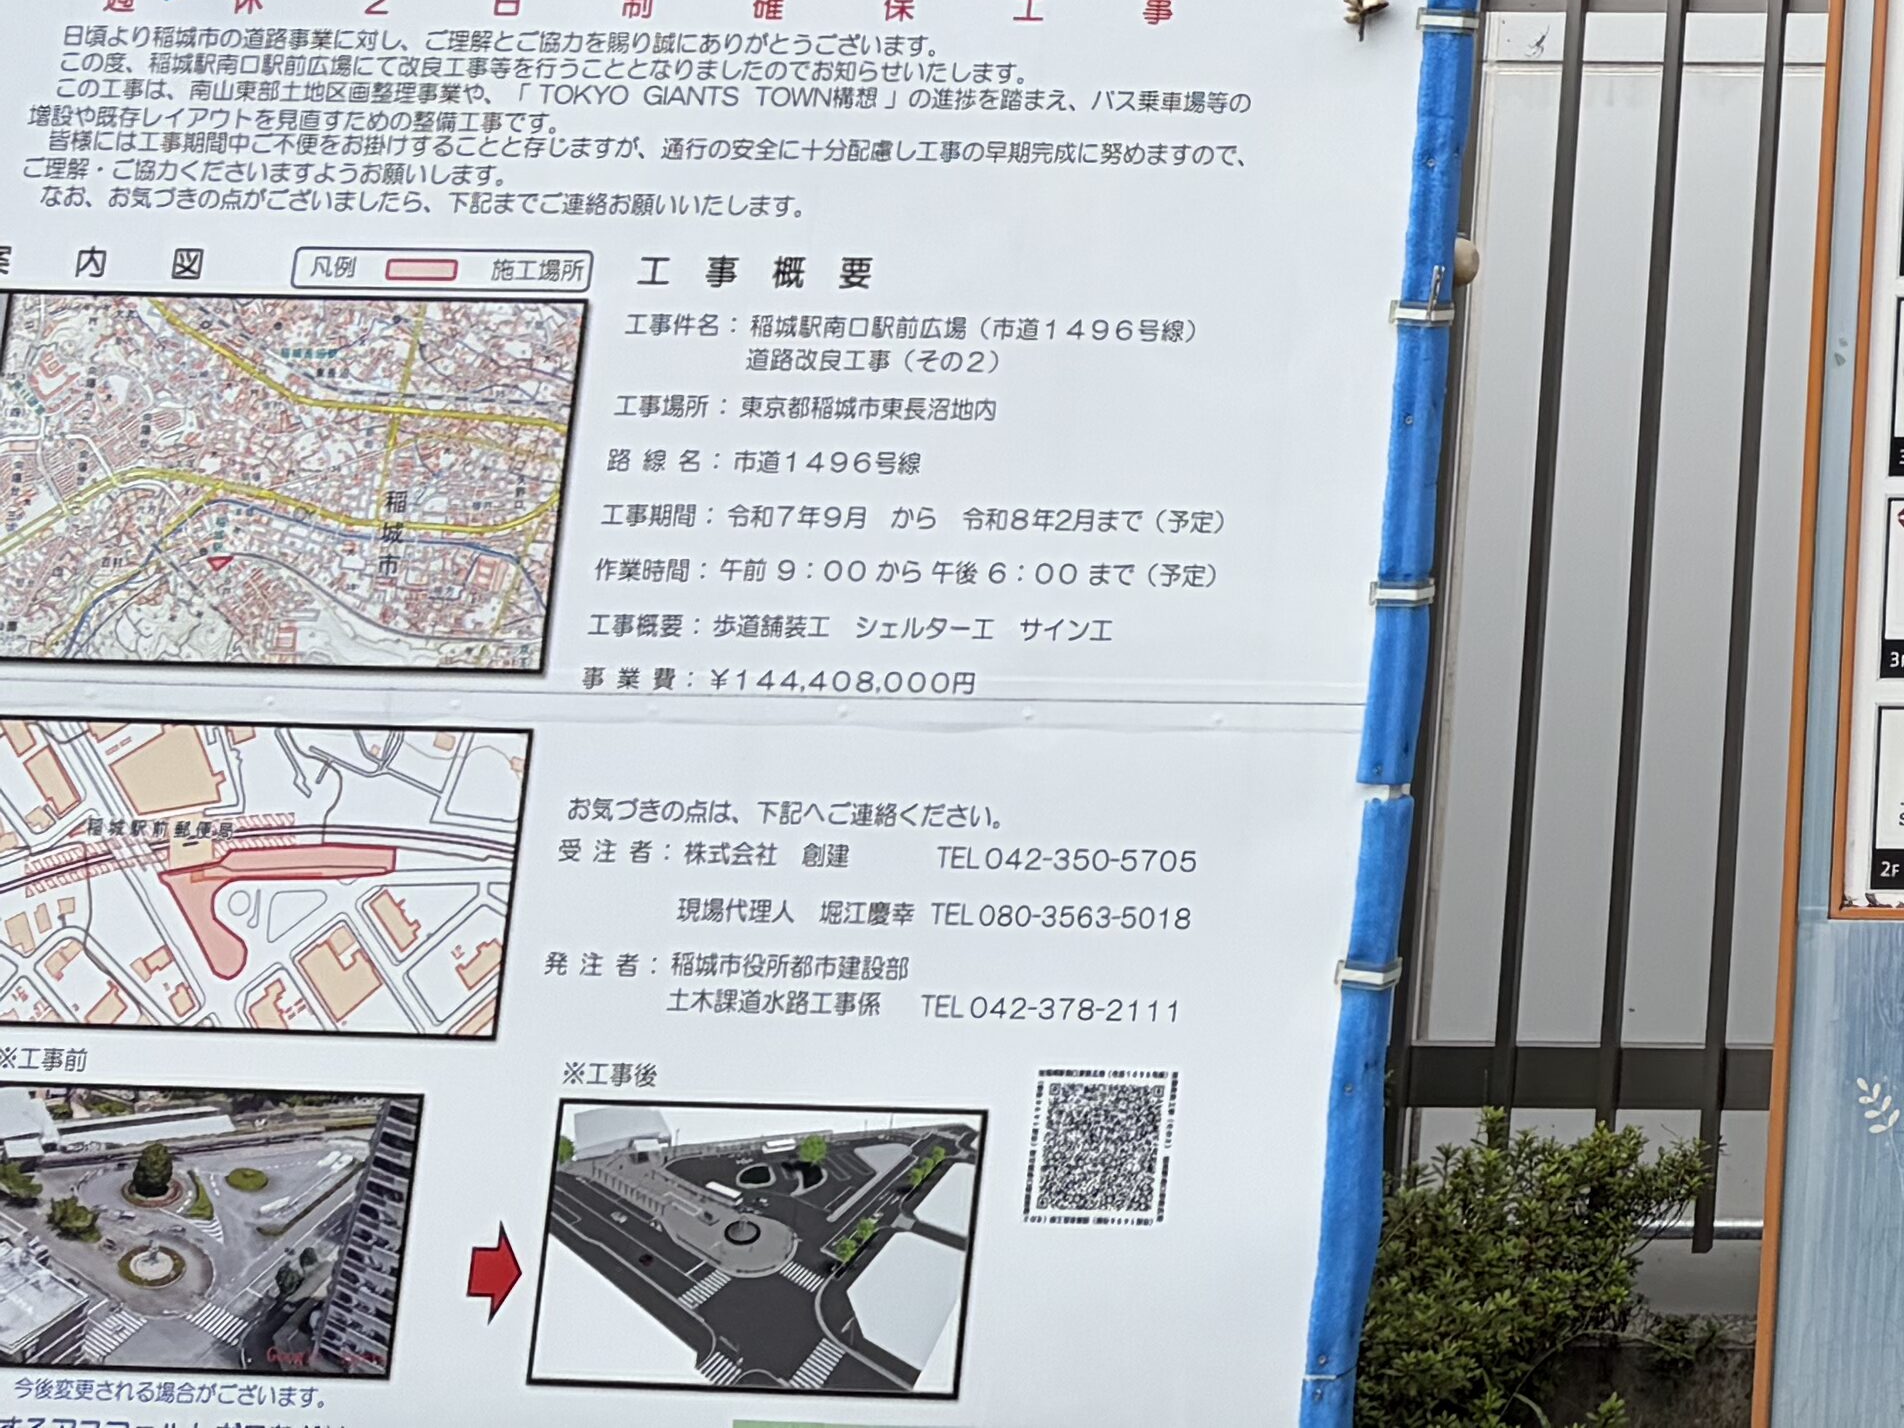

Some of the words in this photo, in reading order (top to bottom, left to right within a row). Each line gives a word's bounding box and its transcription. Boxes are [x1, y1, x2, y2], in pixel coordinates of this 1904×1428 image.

[540, 84, 629, 107] TOKYO
[644, 86, 739, 107] GIANTS
[27, 105, 557, 134] 増設や既存レイアウトを見直すための整備工事です。
[22, 158, 504, 188] ご理解・ご協力くださいますようお願いします。
[309, 255, 356, 278] 凡例
[490, 258, 585, 283] 施工場所
[739, 395, 997, 423] 東京都稲城市東長沼地内
[712, 613, 831, 639] 歩道舗装工
[568, 797, 1000, 830] お気づきの点は、下記へご連絡ください。
[684, 841, 778, 867] 株式会社
[801, 842, 850, 869] 創建
[1880, 861, 1901, 878] 2F
[676, 897, 795, 924] 現場代理人
[671, 952, 909, 982] 稲城市役所都市建設部
[666, 989, 882, 1017] 土木課道水路工事係
[14, 1377, 326, 1410] 今後変更される場合がございます。
